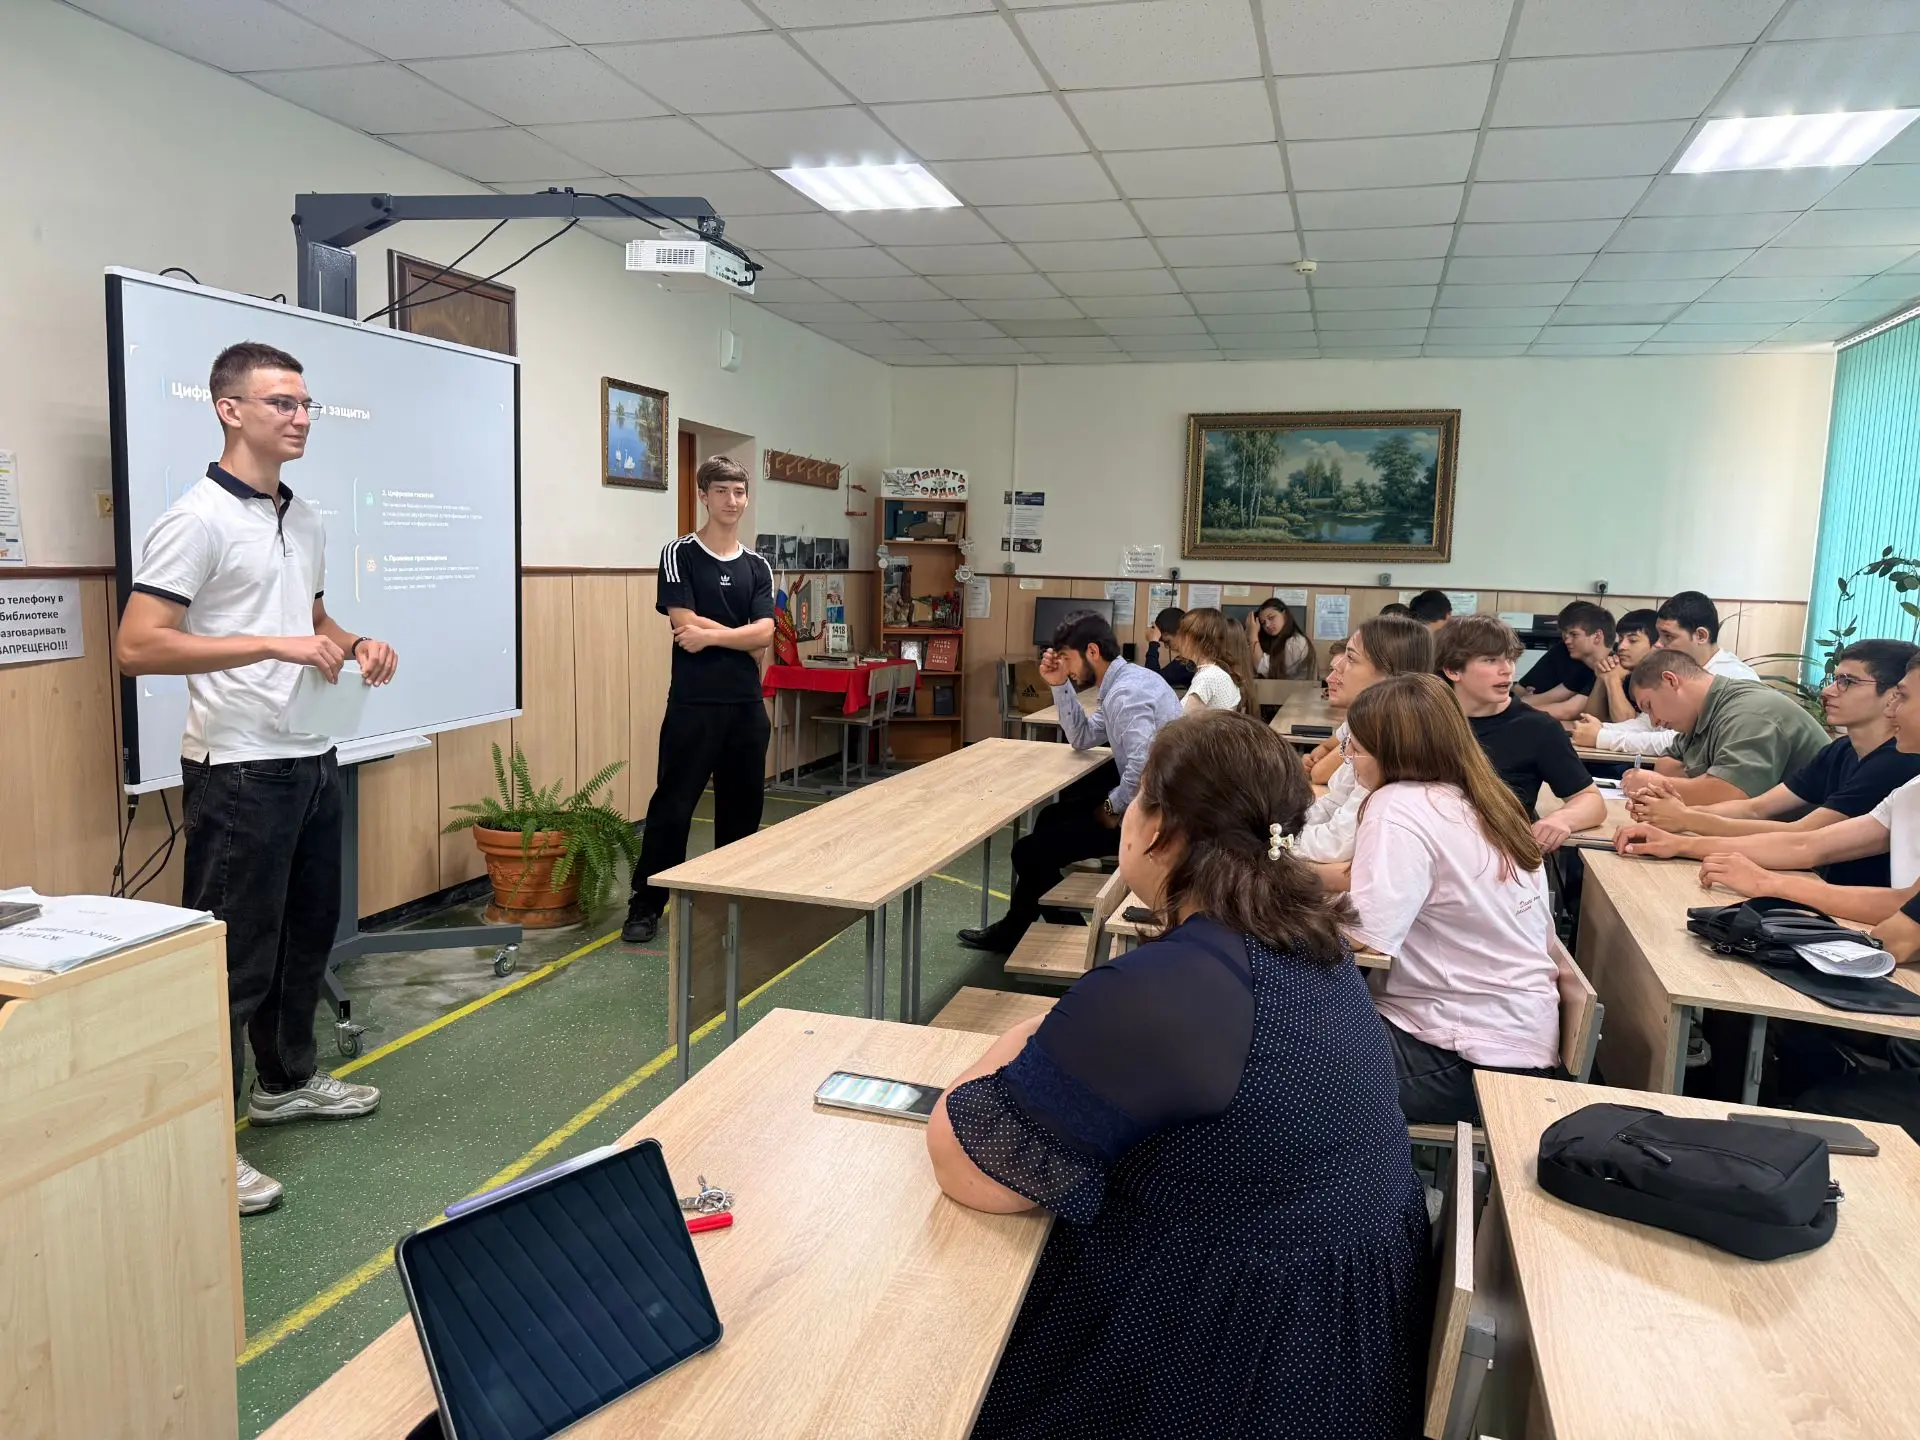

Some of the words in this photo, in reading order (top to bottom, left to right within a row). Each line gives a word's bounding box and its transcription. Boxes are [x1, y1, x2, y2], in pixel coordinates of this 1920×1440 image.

[329, 405, 370, 420] защиты
[7, 594, 56, 605] телефону
[0, 611, 59, 621] библиотеке
